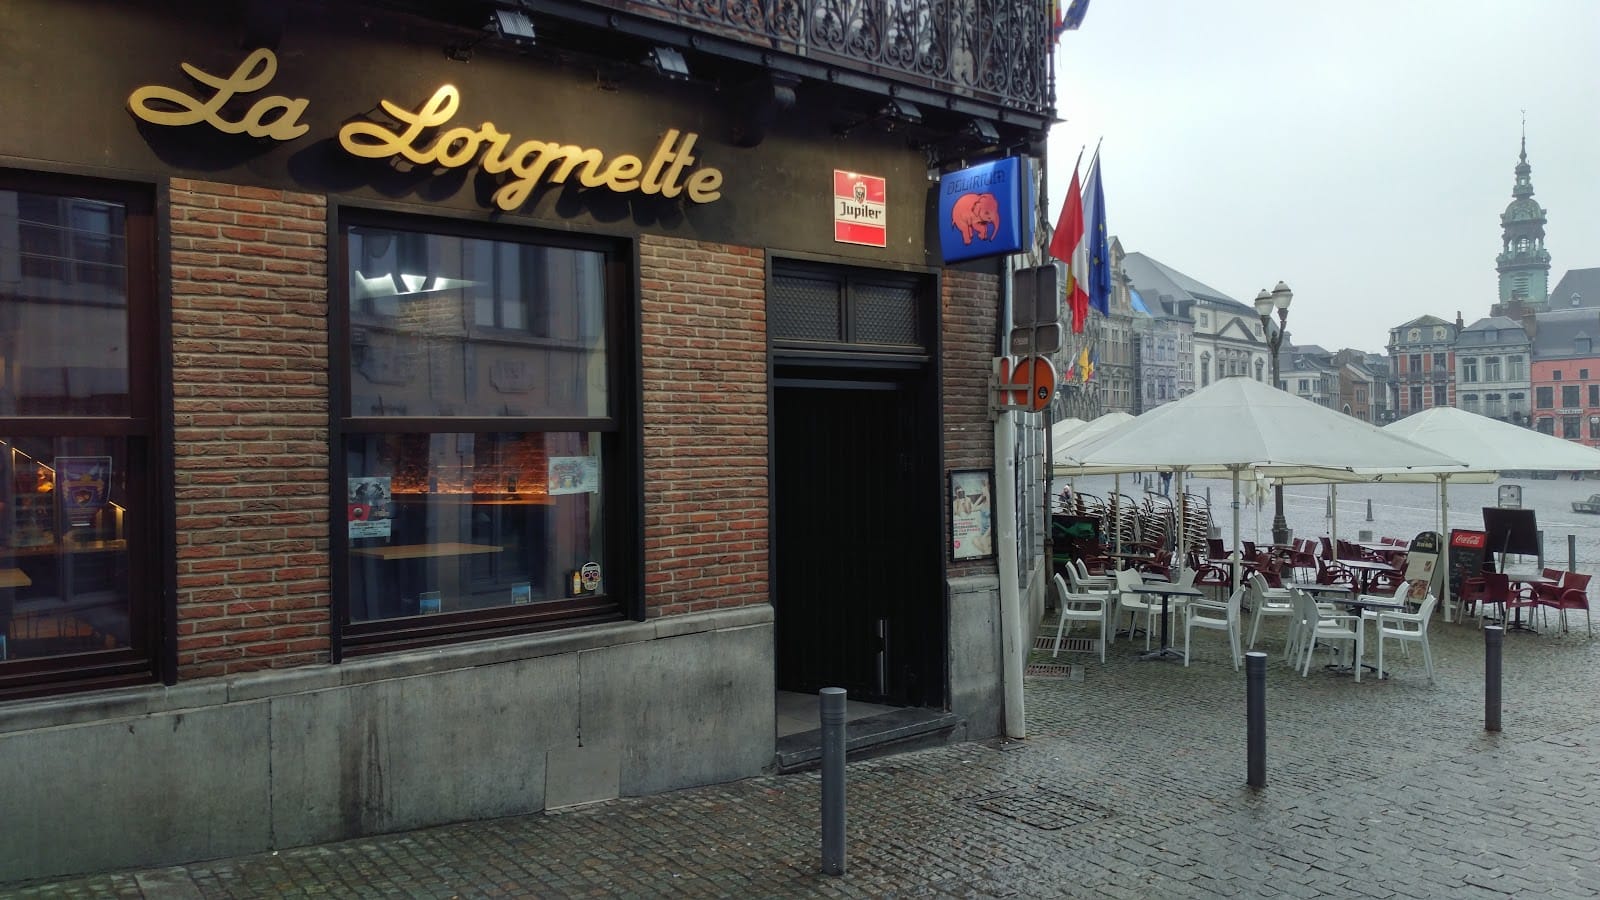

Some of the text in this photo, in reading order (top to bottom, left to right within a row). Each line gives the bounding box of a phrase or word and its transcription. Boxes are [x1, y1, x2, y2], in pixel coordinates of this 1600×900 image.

[127, 47, 724, 211] La Lorgnette
[946, 169, 1006, 195] DELIRIUM
[839, 201, 882, 219] Jupiler
